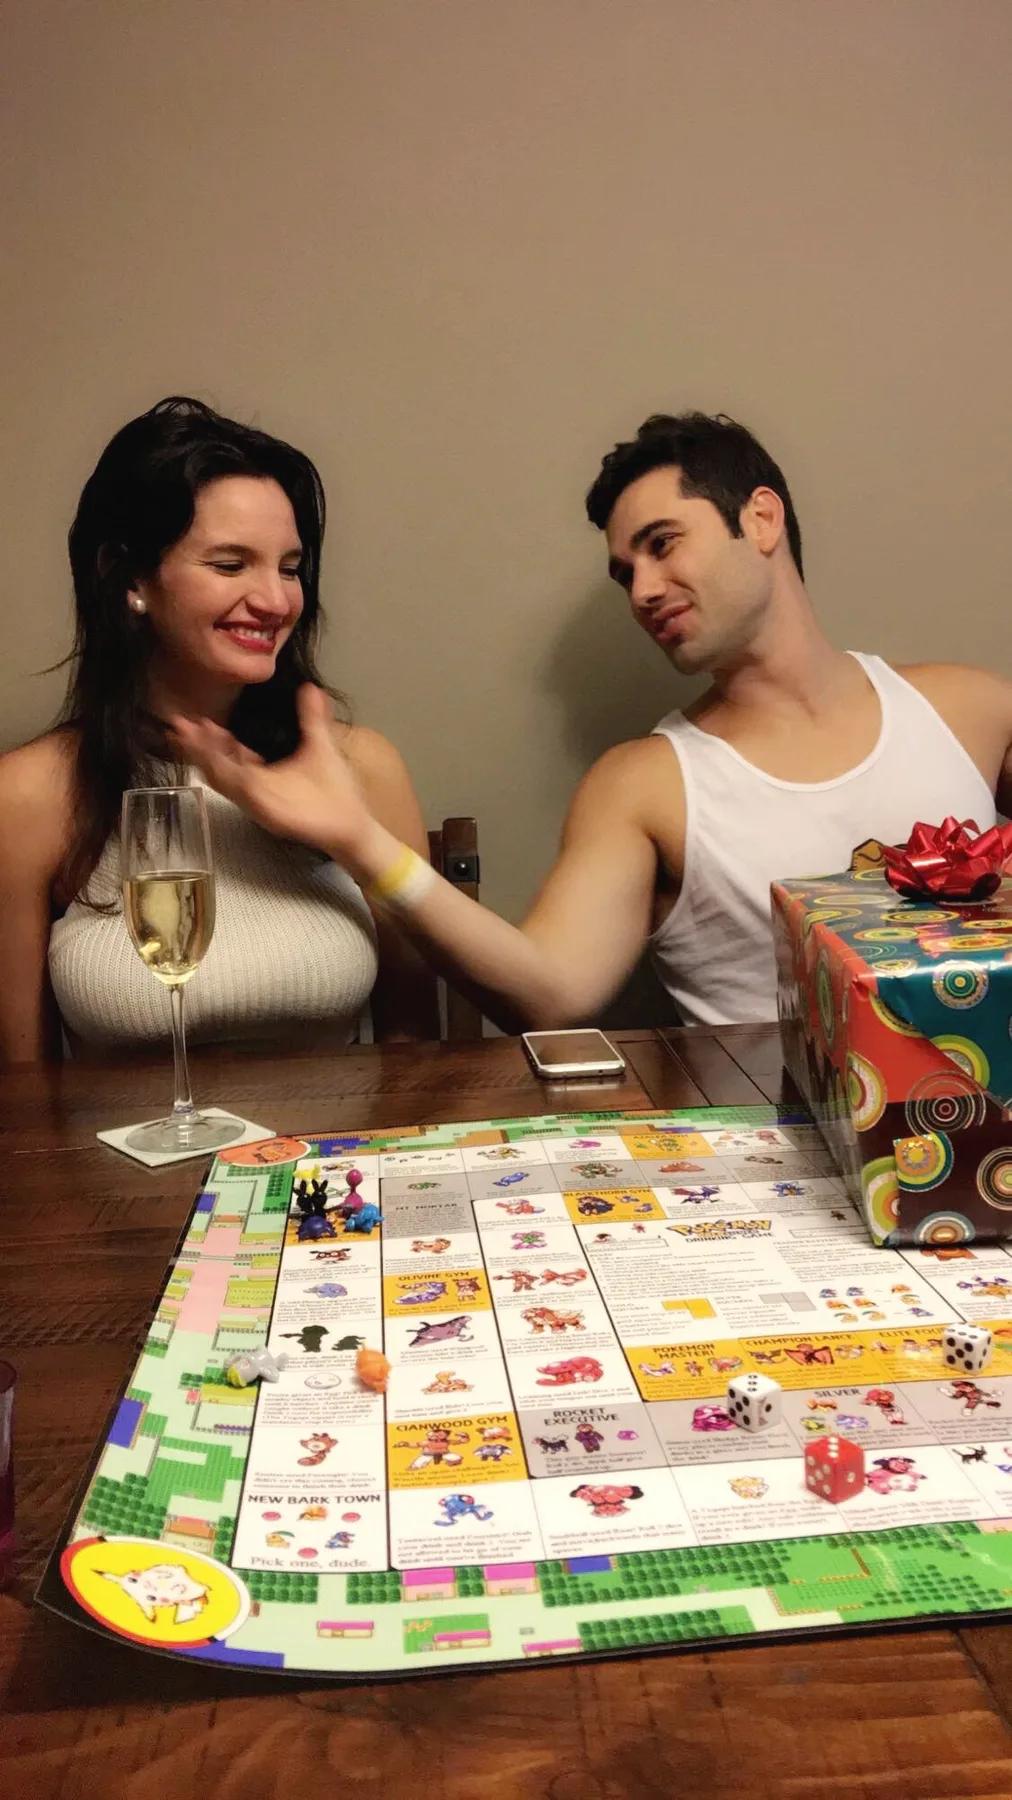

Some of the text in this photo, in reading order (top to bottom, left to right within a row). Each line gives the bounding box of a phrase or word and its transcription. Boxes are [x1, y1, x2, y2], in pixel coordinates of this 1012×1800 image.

[398, 1270, 470, 1281] OLIVINE GYM
[746, 1333, 855, 1346] CHAMPION LANCE
[878, 1330, 909, 1338] ELITE
[659, 1350, 715, 1360] MASTER!
[814, 1388, 862, 1398] SILVER
[553, 1407, 606, 1418] ROCKET
[396, 1414, 508, 1432] CIANWOOD GYM
[543, 1413, 621, 1426] EXECUTIVE
[248, 1493, 381, 1505] NEW BARK TOWN
[250, 1556, 372, 1569] Pick one, dude.
